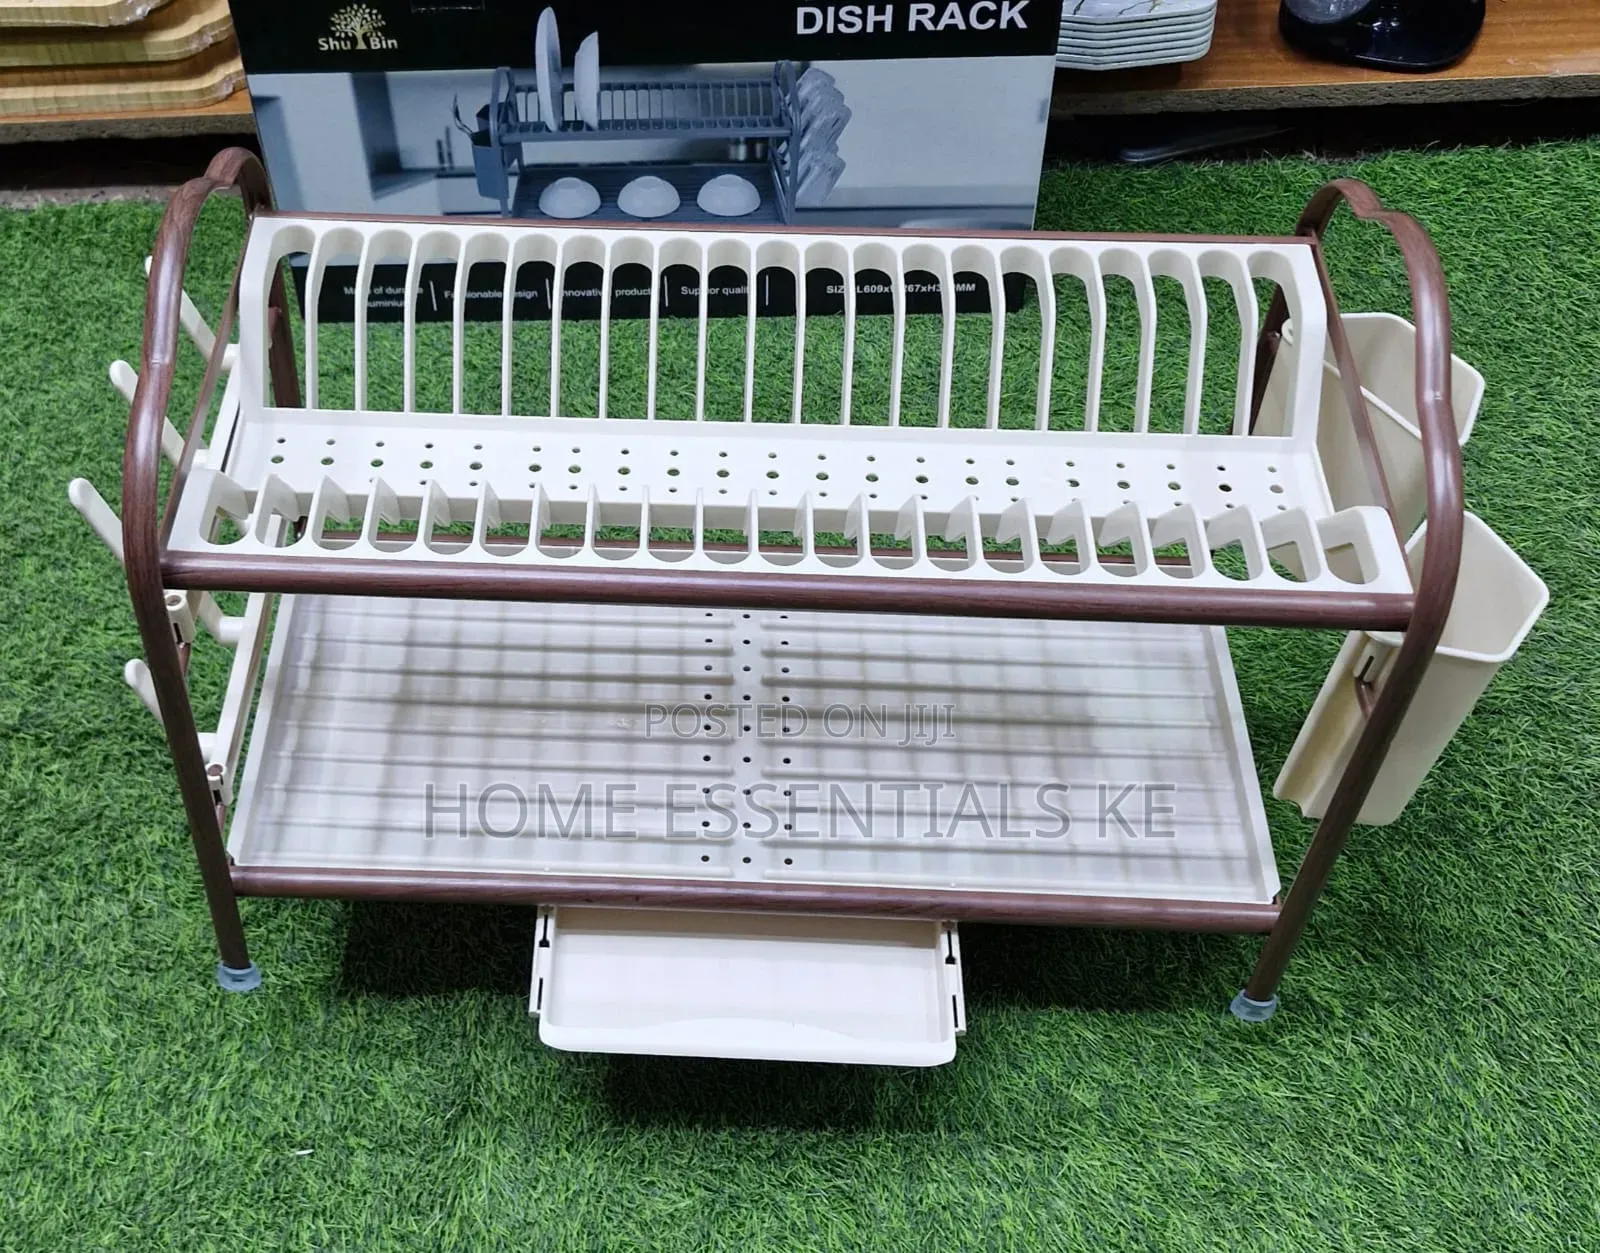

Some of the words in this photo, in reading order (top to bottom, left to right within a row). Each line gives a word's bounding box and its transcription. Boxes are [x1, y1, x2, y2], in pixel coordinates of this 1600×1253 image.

[796, 4, 893, 35] DISH
[907, 0, 1030, 31] RACK
[317, 37, 351, 51] Shu
[369, 36, 399, 50] Bin
